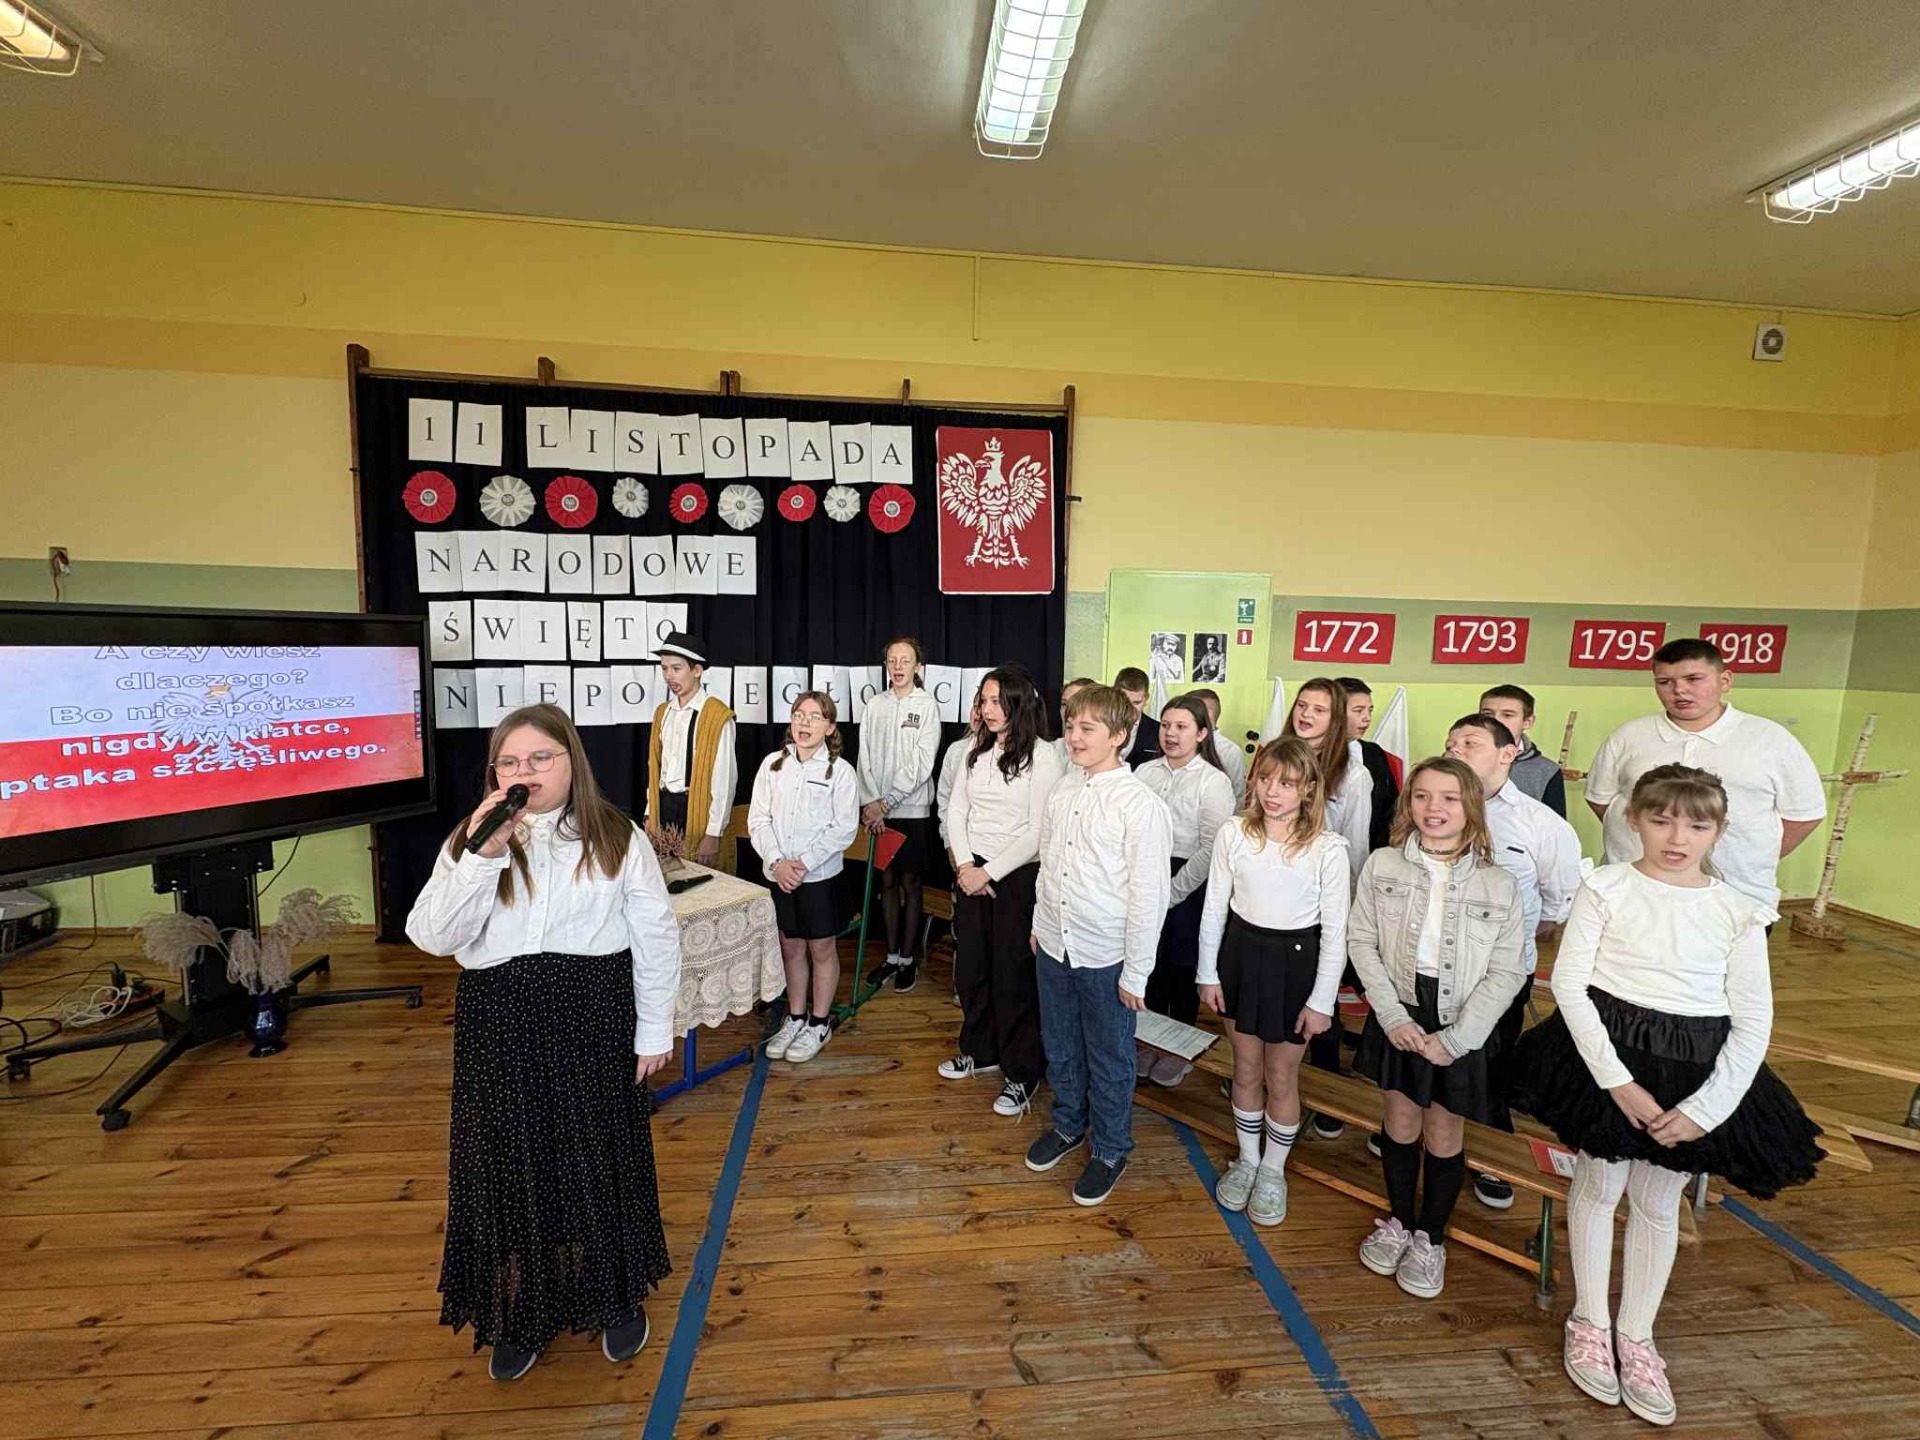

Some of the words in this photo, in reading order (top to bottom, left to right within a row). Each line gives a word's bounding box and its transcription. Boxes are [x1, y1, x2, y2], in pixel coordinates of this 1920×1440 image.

[424, 416, 484, 446] 11
[539, 424, 903, 466] LISTOPADA
[429, 548, 746, 577] NARODOWE
[443, 612, 677, 648] ŚWIĘTO
[1303, 620, 1380, 654] 1772
[1442, 620, 1517, 653] 1793
[1578, 628, 1656, 661] 1795
[95, 646, 129, 660] A
[141, 646, 210, 663] czy
[222, 646, 322, 659] wiesz
[116, 669, 309, 690] dlaczego?
[50, 705, 113, 725] Bo
[127, 702, 191, 720] nie
[203, 696, 355, 718] spotkasz
[61, 733, 180, 756] nigdy
[195, 732, 224, 745] w
[238, 722, 351, 742] klatce,
[0, 768, 136, 800] ptaka
